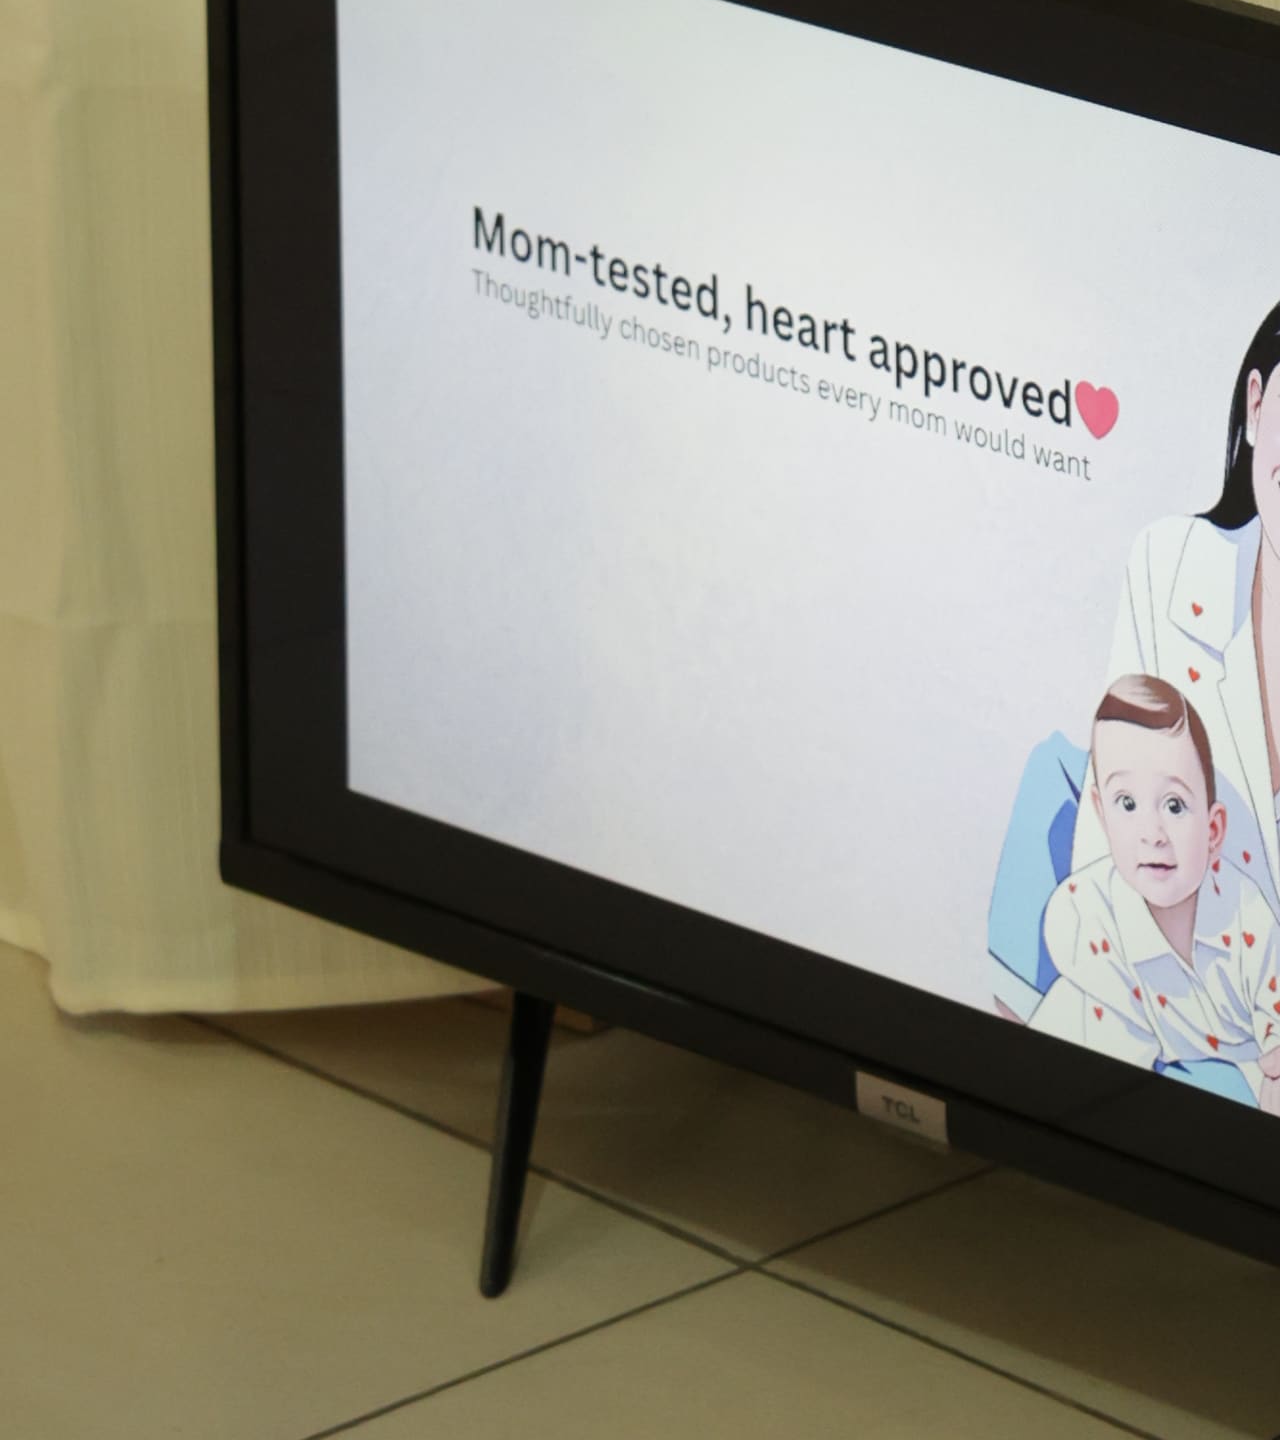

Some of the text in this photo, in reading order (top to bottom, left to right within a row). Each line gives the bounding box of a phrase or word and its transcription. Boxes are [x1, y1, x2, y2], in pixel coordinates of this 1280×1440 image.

[472, 205, 1073, 428] Mom-tested, heart approved
[472, 269, 1093, 482] Thoughtfully chosen products every mom would want
[880, 1095, 921, 1125] TCL
